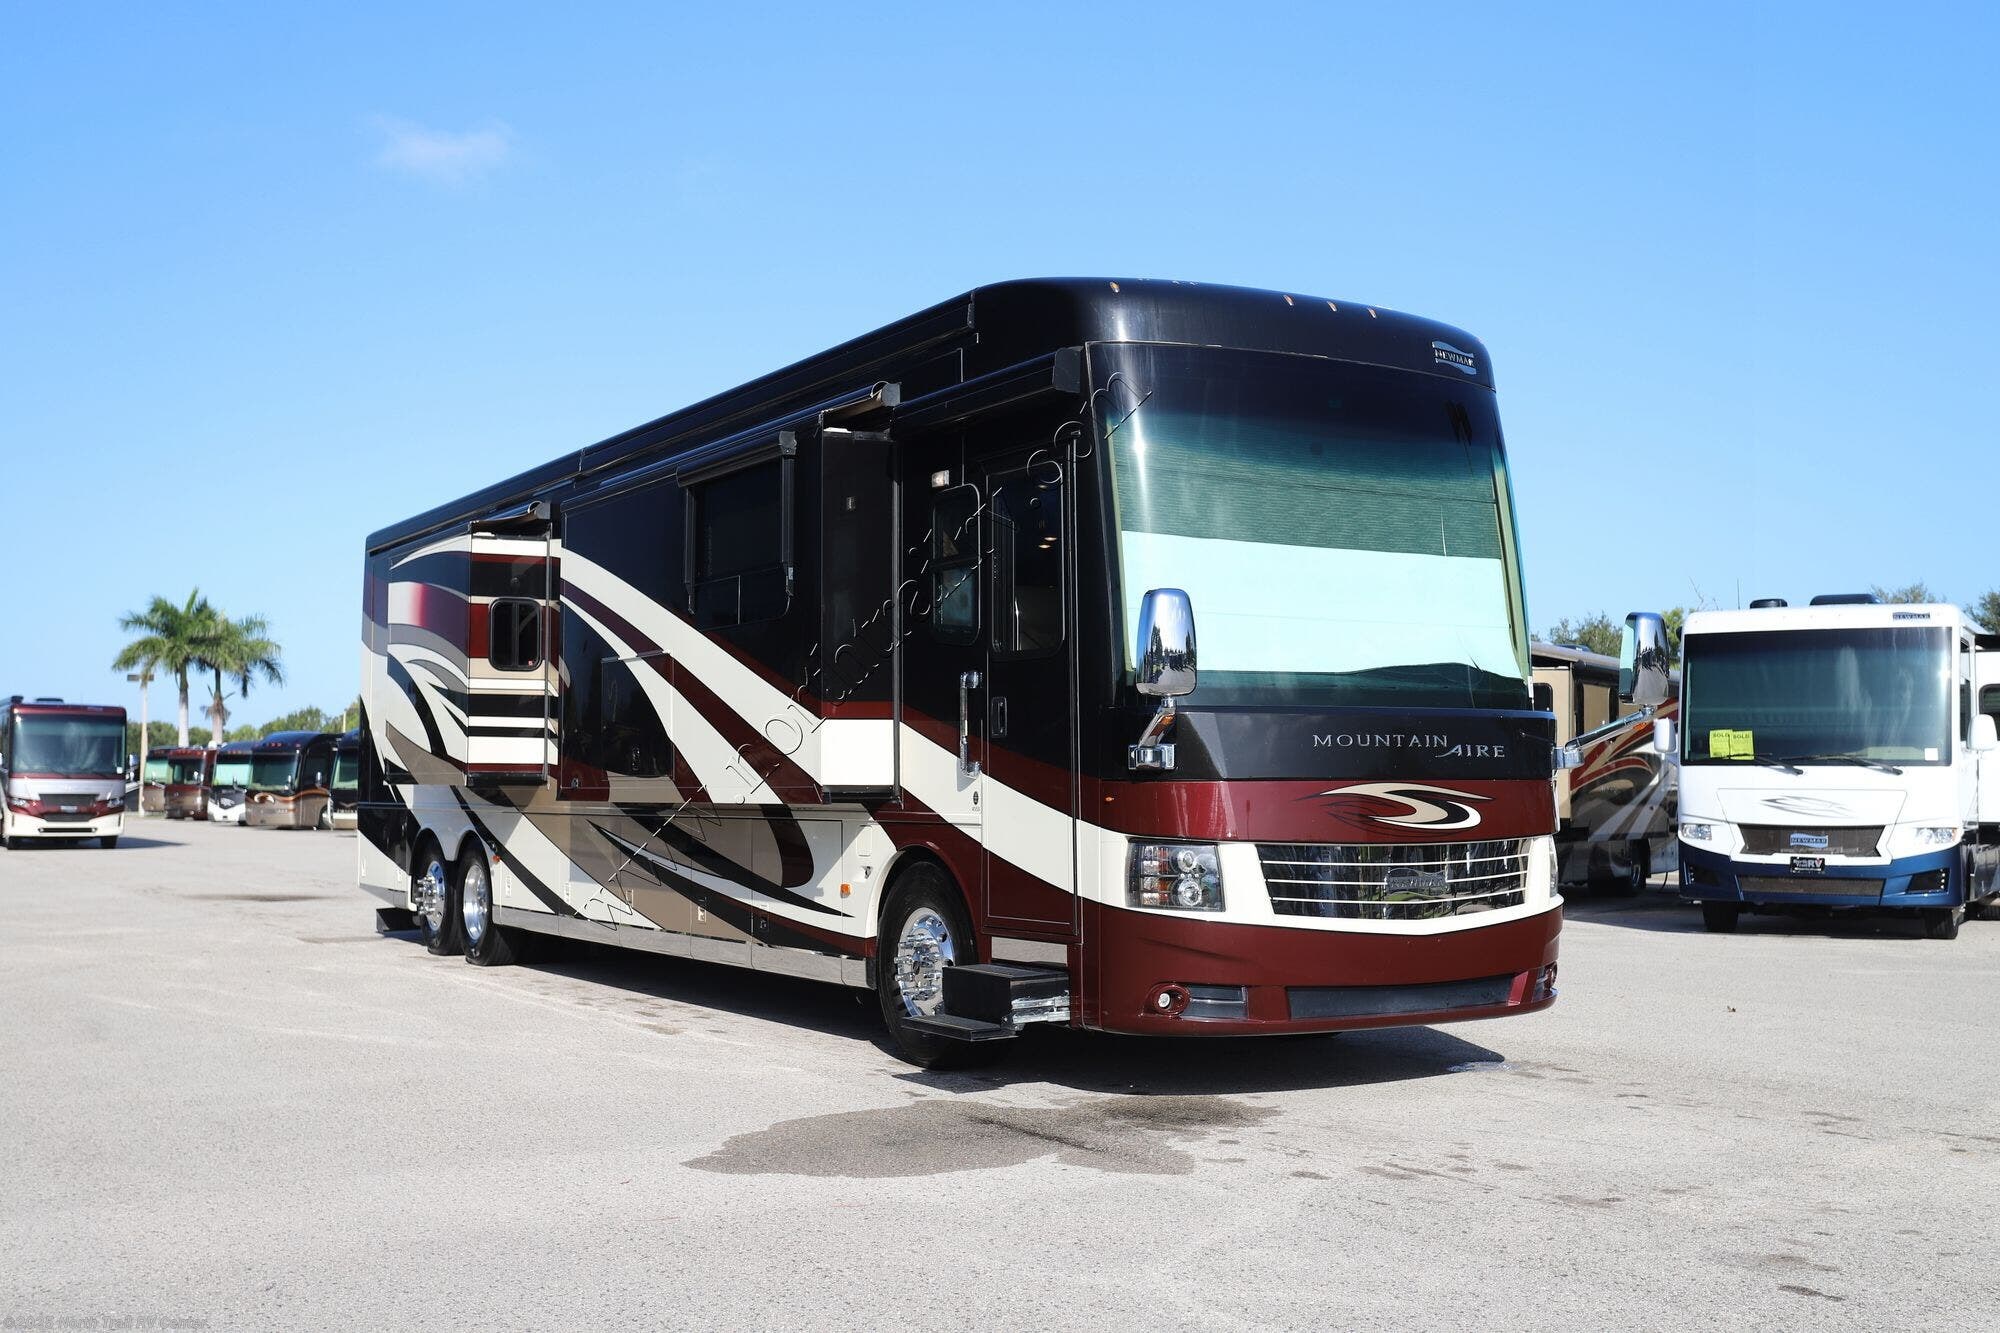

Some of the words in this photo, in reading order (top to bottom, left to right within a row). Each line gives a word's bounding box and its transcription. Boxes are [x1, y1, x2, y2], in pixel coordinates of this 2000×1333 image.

[1433, 349, 1475, 367] NEWMAR
[1312, 733, 1449, 748] MOUNTAIN
[1435, 744, 1506, 758] AIRE
[1808, 859, 1823, 868] RV
